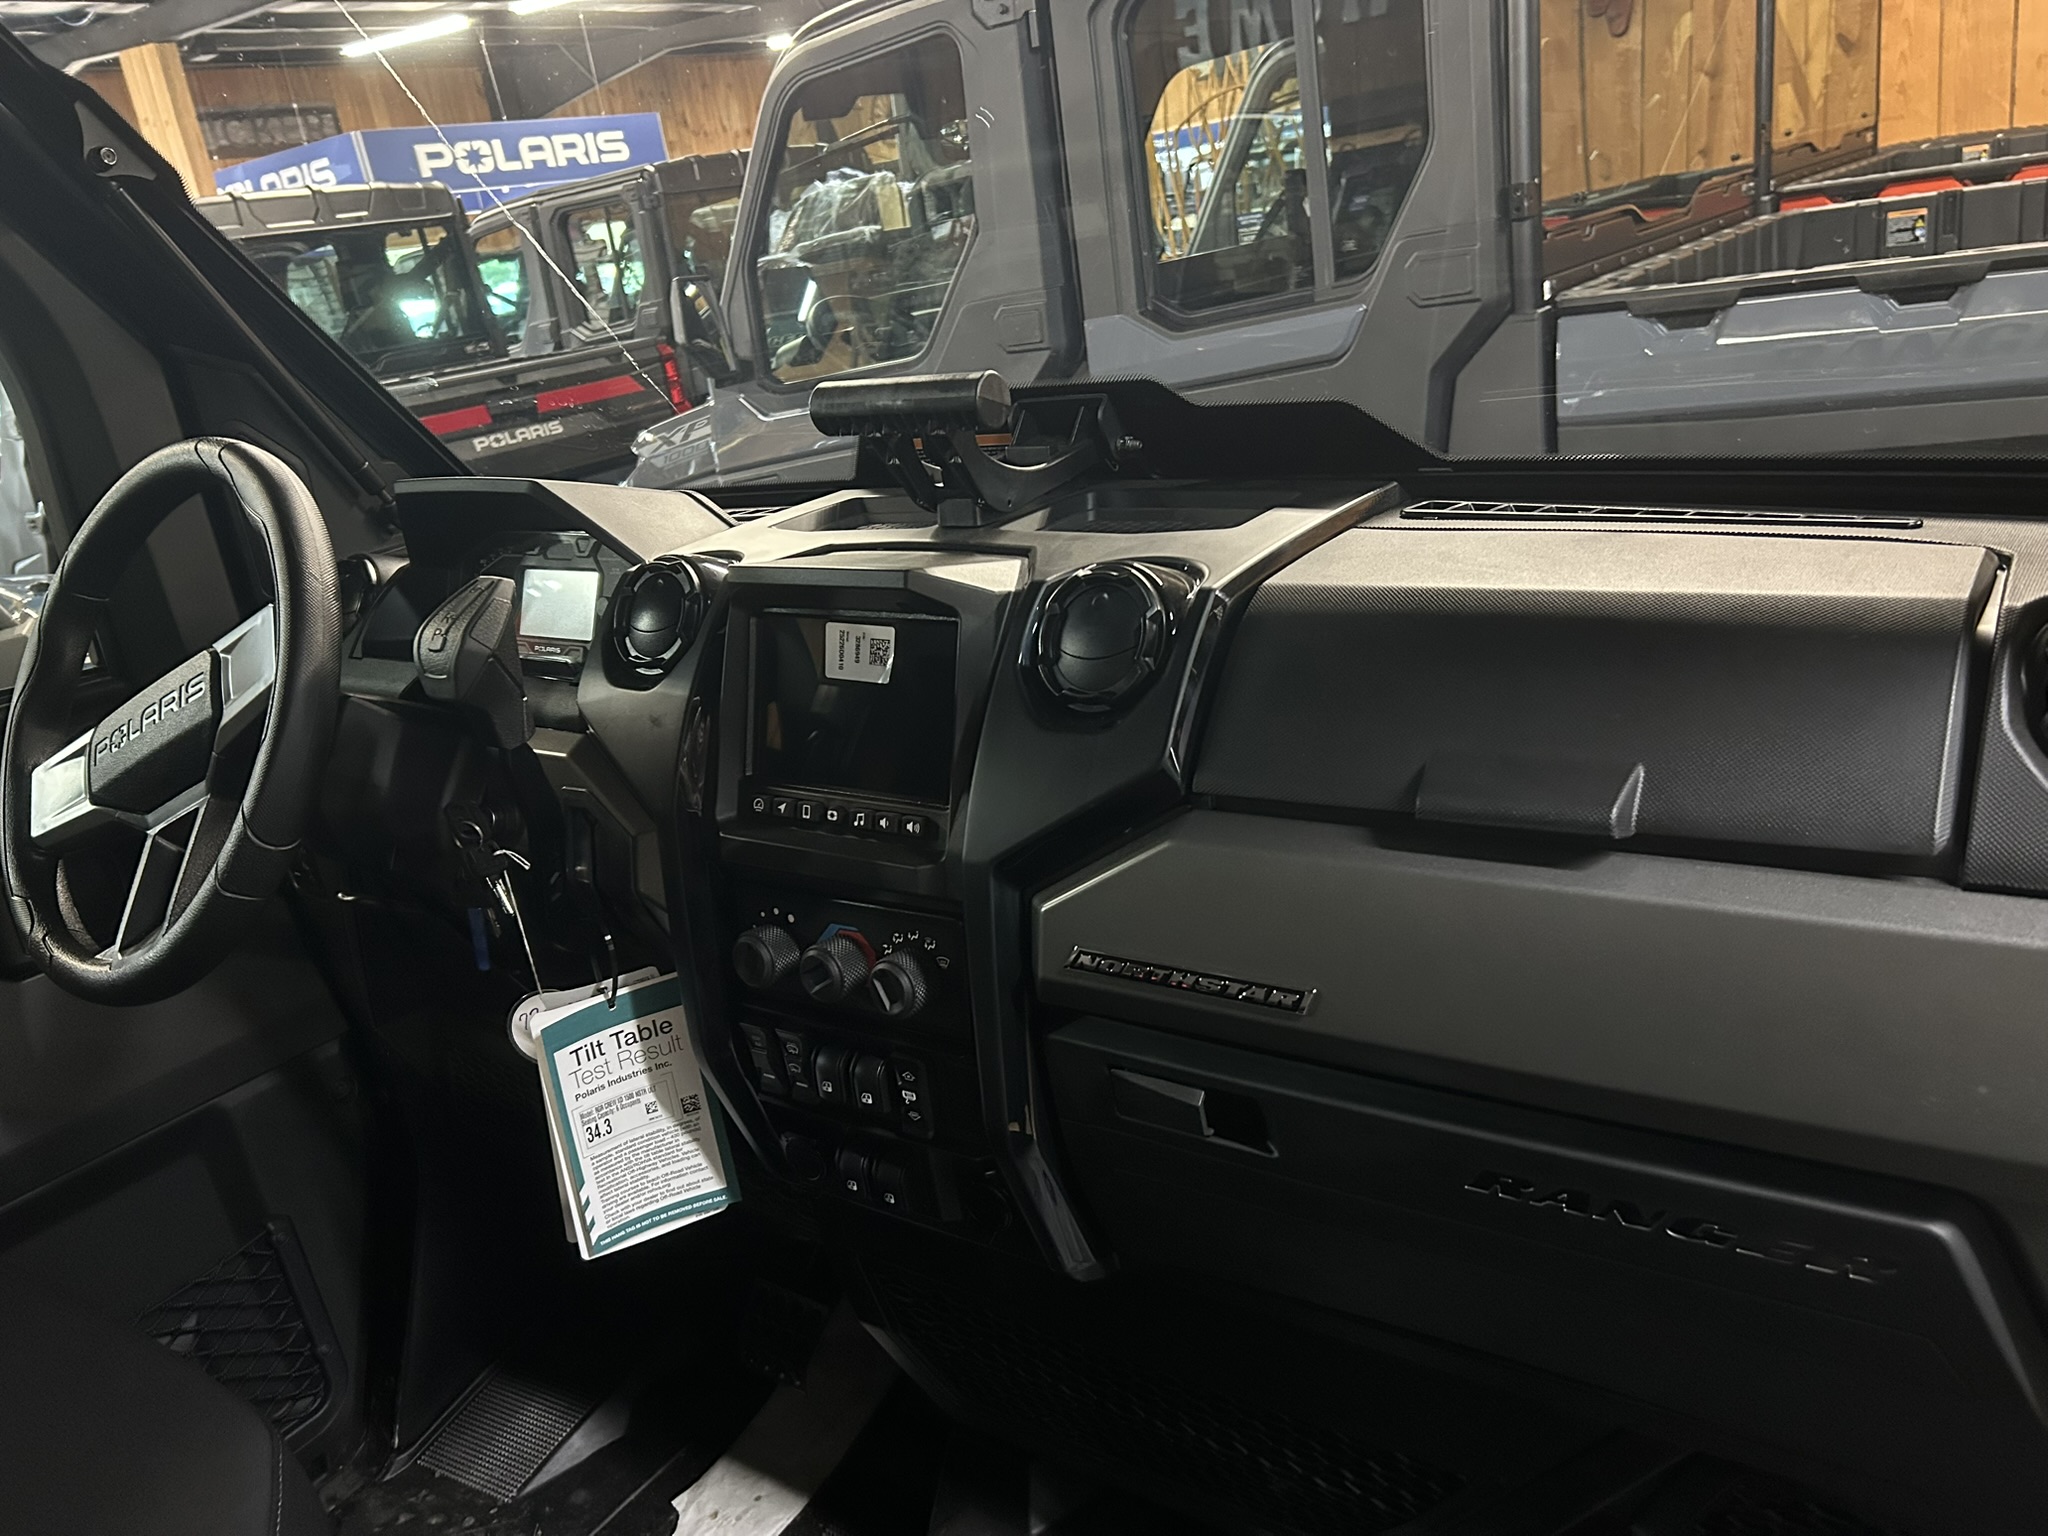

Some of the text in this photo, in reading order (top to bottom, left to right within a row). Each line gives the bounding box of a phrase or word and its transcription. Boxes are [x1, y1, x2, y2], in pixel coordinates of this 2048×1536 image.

[413, 130, 630, 178] POLARIS
[472, 420, 564, 452] POLARIS
[650, 418, 710, 454] XP
[663, 440, 708, 464] 1000
[431, 627, 443, 641] P
[534, 645, 561, 653] POLARIS
[94, 671, 206, 766] POLARIS
[1076, 954, 1300, 1011] NORTHSTAR
[568, 1035, 684, 1088] Test Result
[569, 1020, 672, 1066] Tilt Table
[574, 1060, 673, 1102] Polaris Industries Inc.
[586, 1119, 613, 1143] 34.3
[600, 1237, 611, 1246] THIS
[611, 1230, 625, 1240] HANG
[625, 1225, 635, 1233] TAG
[641, 1218, 651, 1226] NOT
[667, 1204, 692, 1216] REMOVED
[692, 1198, 713, 1208] BEFORE
[1465, 1170, 1898, 1283] RANGER
